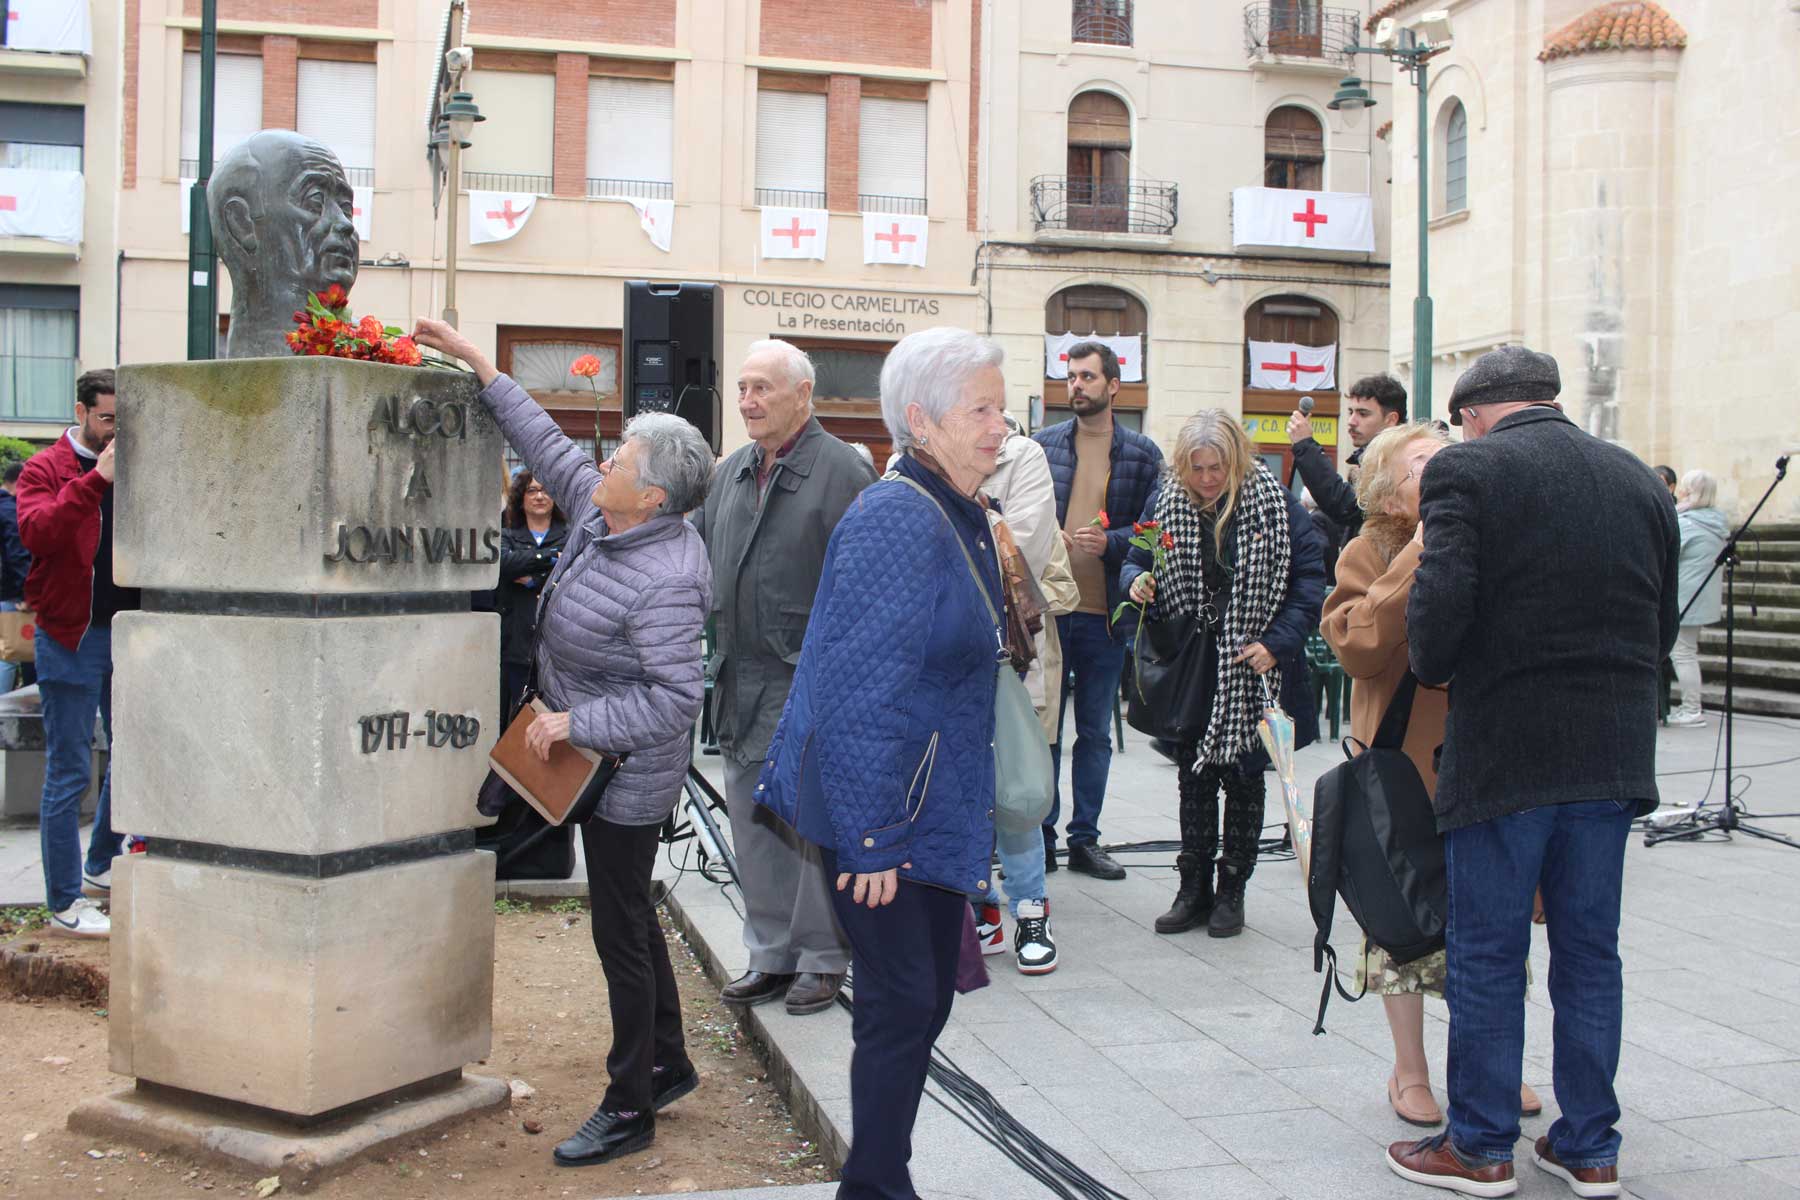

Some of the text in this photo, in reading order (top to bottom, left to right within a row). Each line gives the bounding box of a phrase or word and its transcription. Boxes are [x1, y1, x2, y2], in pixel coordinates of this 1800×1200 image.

[743, 289, 940, 316] COLEGIO CARMELITAS
[777, 311, 905, 334] La Presentación
[369, 395, 468, 440] ALCOI
[404, 462, 433, 499] A
[323, 524, 501, 565] JOAN VALLS
